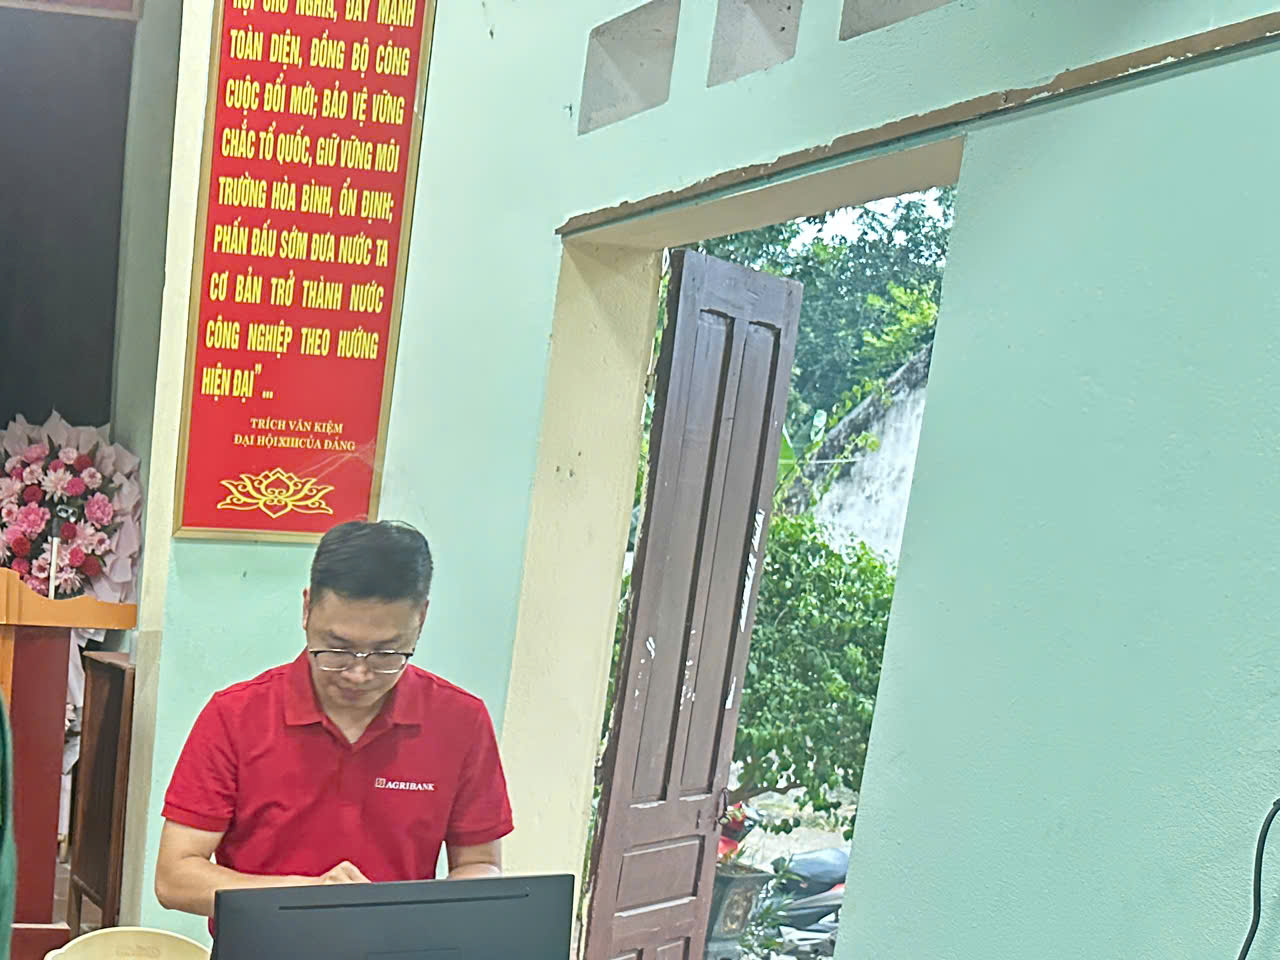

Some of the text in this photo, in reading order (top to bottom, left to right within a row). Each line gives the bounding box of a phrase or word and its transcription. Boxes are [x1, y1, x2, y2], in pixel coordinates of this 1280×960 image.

[377, 0, 416, 31] MẠNH
[230, 24, 264, 61] TOÀN
[269, 29, 302, 70] DIỆN,
[351, 37, 369, 78] BỘ
[375, 40, 410, 76] CÔNG
[225, 72, 405, 127] CUỘC ĐỔI MỚI; BẢO VỆ VỮNG
[259, 121, 276, 160] TỔ
[277, 125, 312, 168] QUỐC,
[316, 133, 340, 167] GIỮ
[340, 135, 372, 170] VỮNG
[374, 138, 400, 173] MÔI
[218, 171, 394, 224] TRƯỜNG HÒA BÌNH, ỔN ĐỊNH;
[213, 216, 388, 267] PHẤN ĐẤU SỚM ĐƯA NƯỚC TA
[209, 266, 384, 313] CƠ BẢN TRỞ THÀNH NƯỚC
[205, 314, 379, 359] CÔNG NGHIỆP THEO HƯỚNG
[201, 362, 231, 402] HIỆN
[386, 781, 434, 791] AGRIBANK
